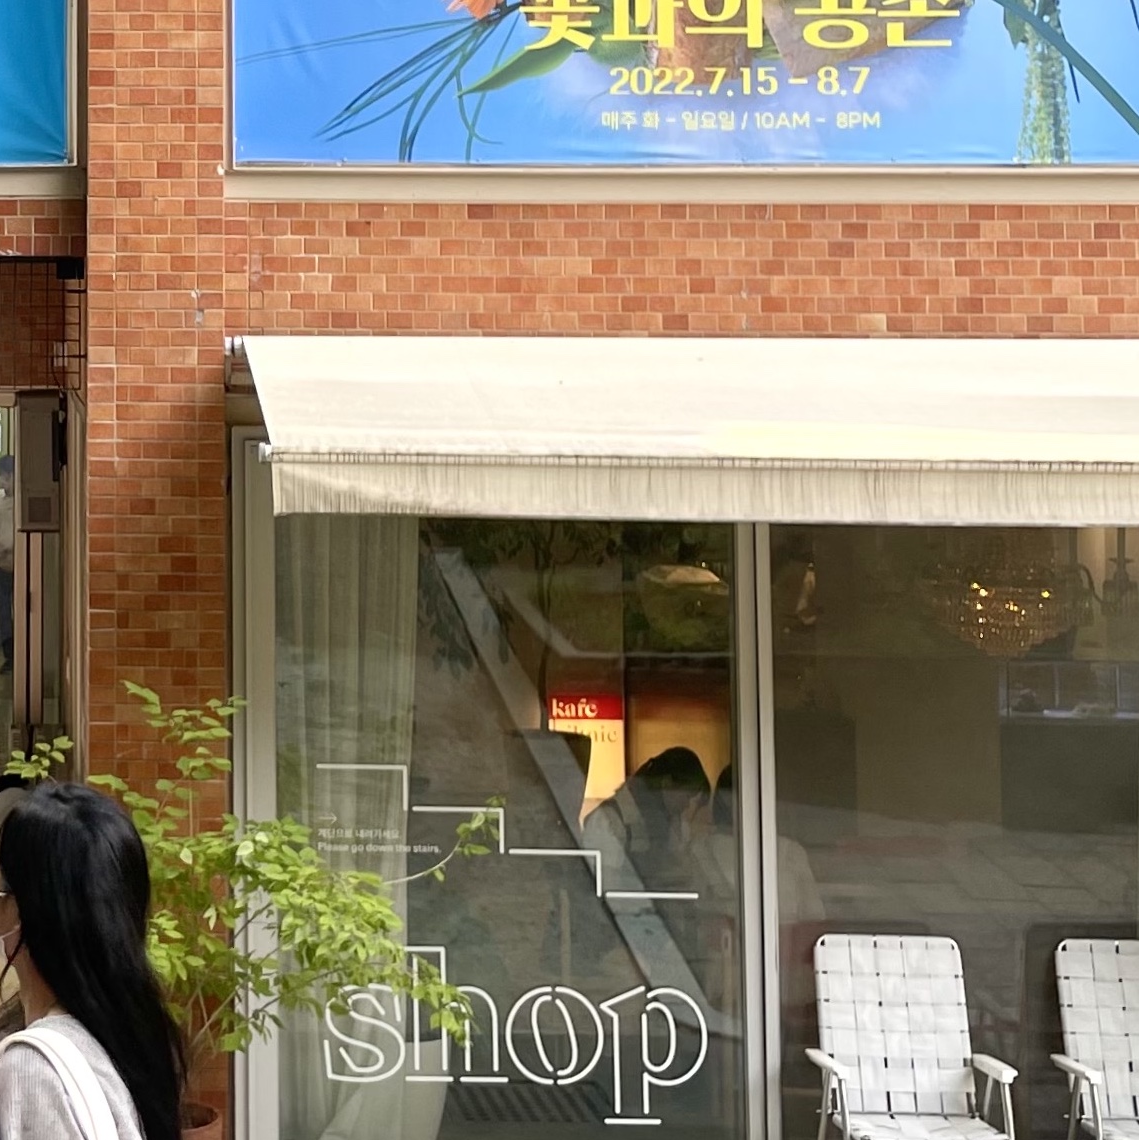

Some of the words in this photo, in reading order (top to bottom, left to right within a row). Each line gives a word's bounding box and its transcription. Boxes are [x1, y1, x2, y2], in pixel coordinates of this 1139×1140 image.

[608, 66, 779, 97] 2022.7.15
[816, 65, 871, 97] 8.7
[601, 110, 638, 131] 매주
[681, 110, 736, 132] 일요일
[754, 110, 811, 130] 10AM
[835, 110, 881, 130] 8PM
[351, 844, 364, 854] go
[324, 946, 708, 1125] shop
